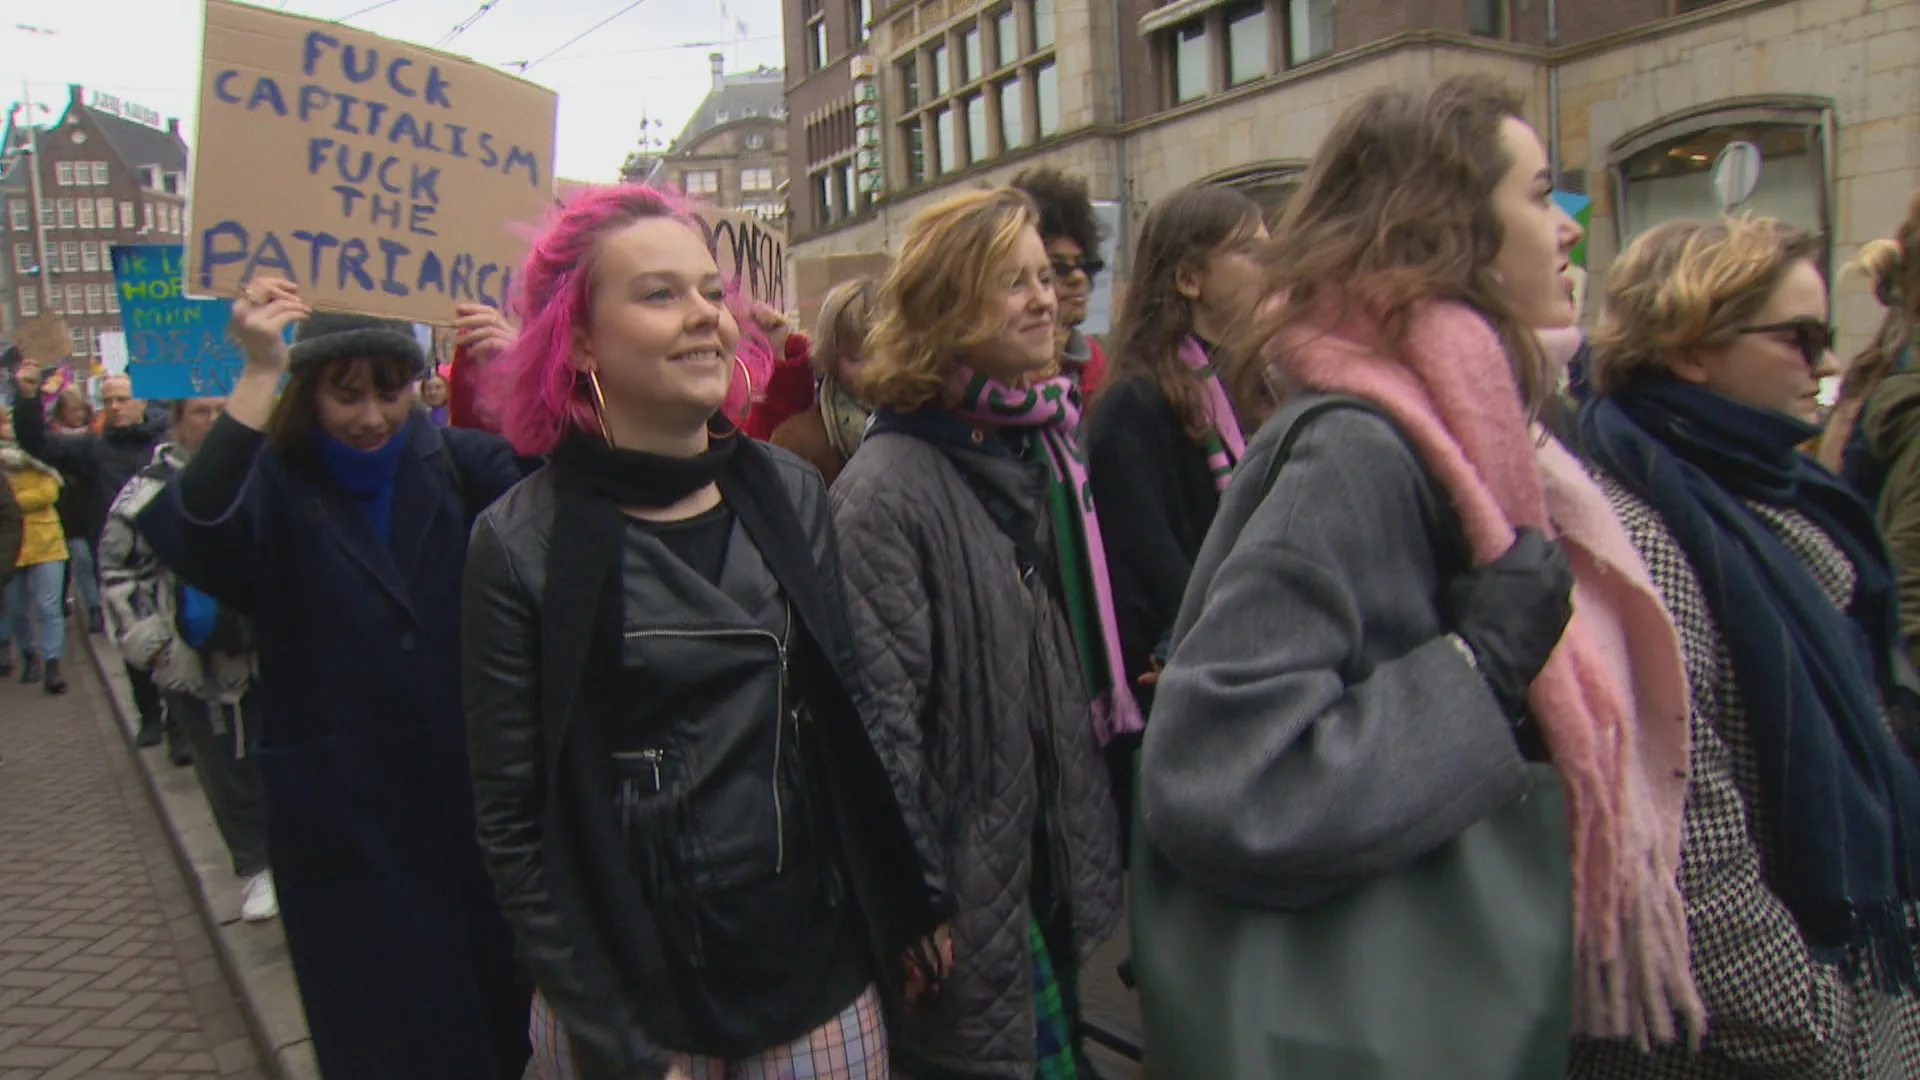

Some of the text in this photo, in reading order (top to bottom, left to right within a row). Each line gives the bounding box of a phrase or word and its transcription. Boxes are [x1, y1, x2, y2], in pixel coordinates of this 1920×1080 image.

[214, 70, 539, 187] CAPITALISM
[309, 137, 440, 204] FUCK
[332, 185, 437, 236] THE
